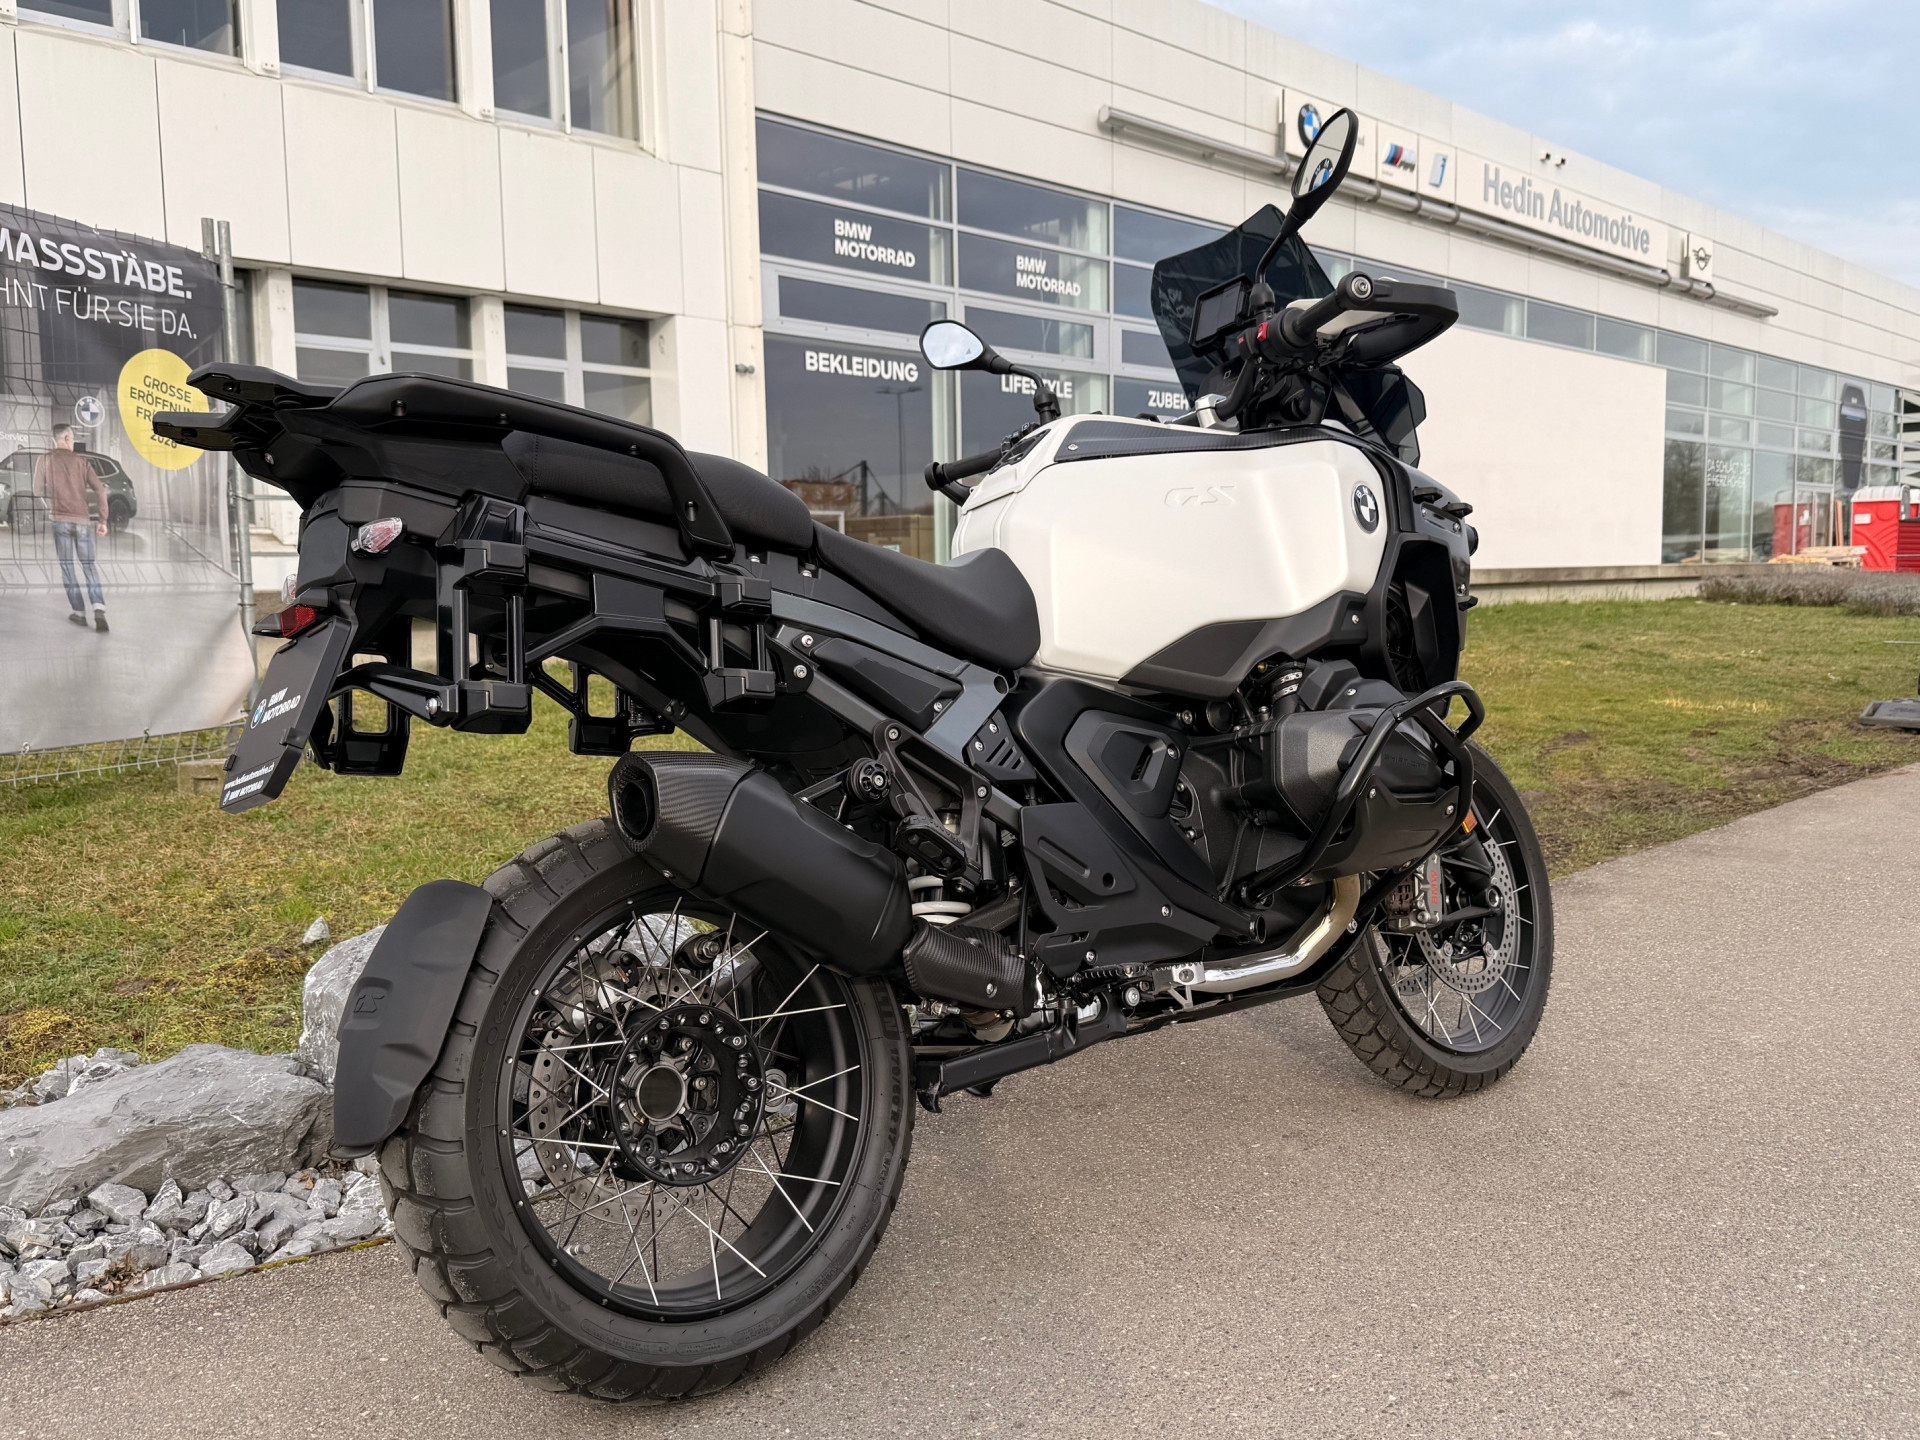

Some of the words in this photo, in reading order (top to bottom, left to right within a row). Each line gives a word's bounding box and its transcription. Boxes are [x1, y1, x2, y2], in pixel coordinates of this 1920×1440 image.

[1483, 163, 1544, 221] Hedin
[1548, 188, 1650, 255] Automotive
[834, 219, 872, 242] BMW
[834, 238, 916, 268] MOTORRAD
[1016, 255, 1047, 273] BMW
[1016, 274, 1081, 297] MOTORRAD
[55, 287, 111, 323] FÜR
[118, 300, 155, 332] SIE
[162, 309, 198, 340] DA.
[805, 350, 919, 382] BEKLEIDUNG
[143, 375, 192, 403] GROSSE
[1001, 373, 1073, 399] LIFESYLE
[1164, 485, 1236, 507] GS
[261, 695, 301, 724] MOTORRAD
[267, 687, 288, 707] BMW
[1431, 869, 1439, 905] BMW
